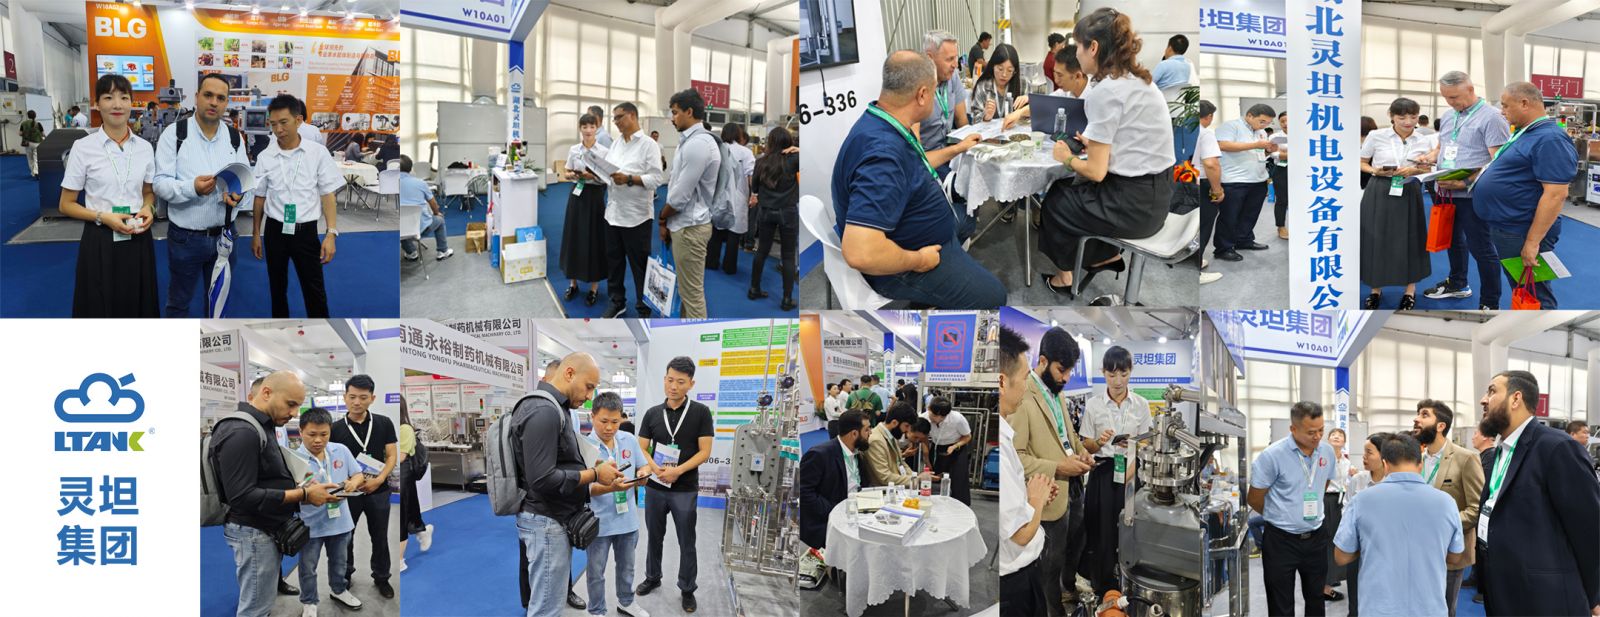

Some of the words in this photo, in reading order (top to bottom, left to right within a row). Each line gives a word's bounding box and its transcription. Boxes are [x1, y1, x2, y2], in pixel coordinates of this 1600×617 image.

[462, 7, 505, 24] W10A01
[95, 16, 147, 39] BLG
[271, 72, 289, 82] BLG
[1539, 78, 1580, 96] 1号门
[1306, 0, 1344, 310] 北灵坦机电设备有限公
[1296, 341, 1333, 353] W10A01
[428, 353, 452, 365] YONGYU
[1133, 352, 1176, 365] 灵坦集团
